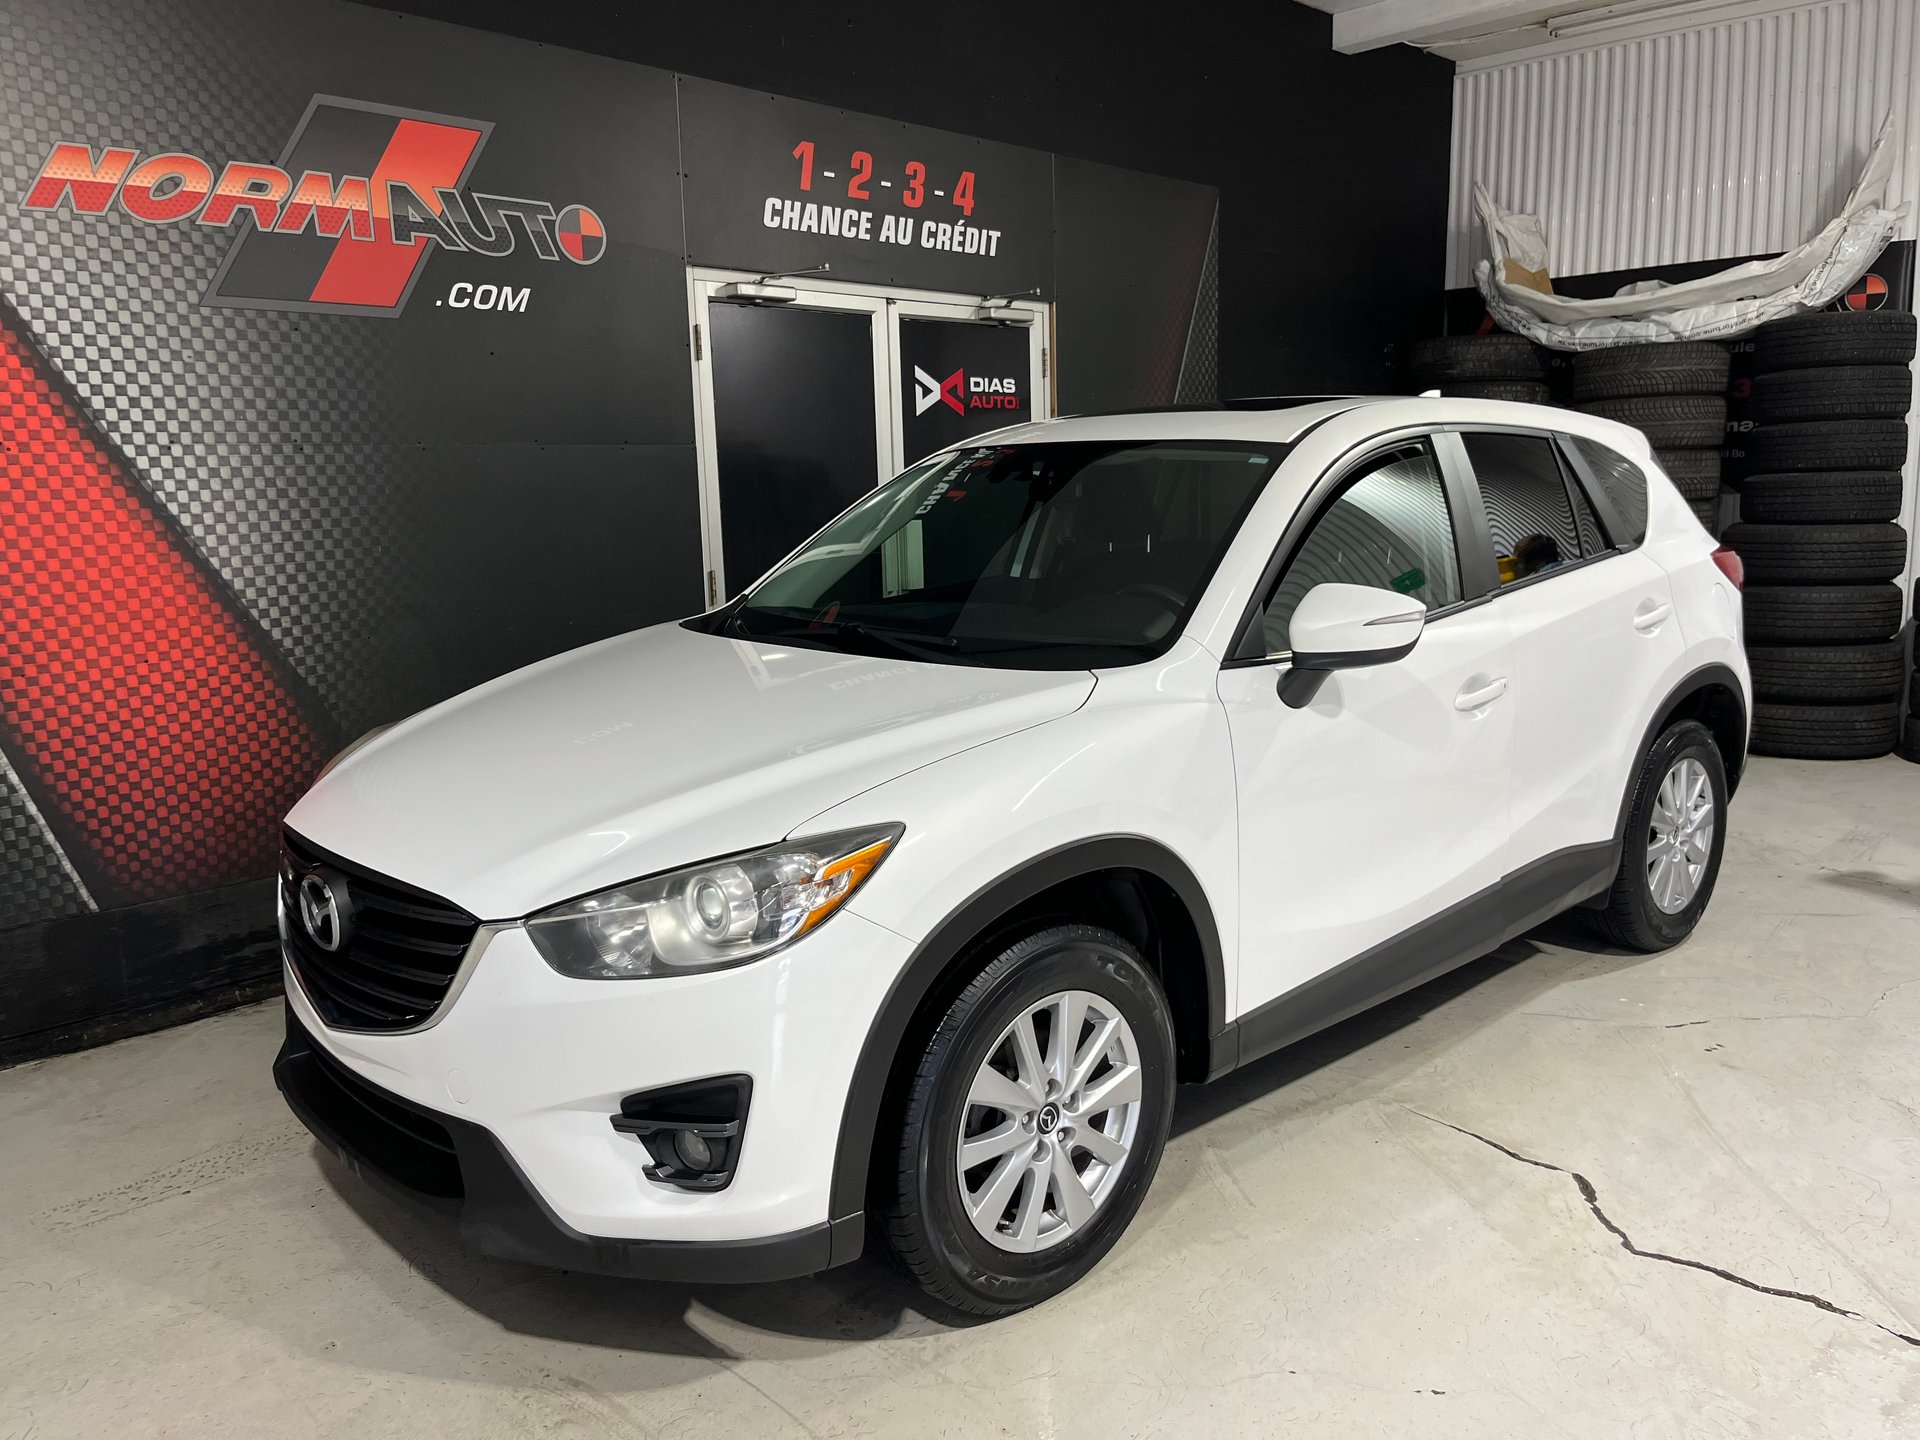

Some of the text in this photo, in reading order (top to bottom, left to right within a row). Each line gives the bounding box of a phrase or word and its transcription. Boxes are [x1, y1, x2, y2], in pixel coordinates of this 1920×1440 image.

[763, 197, 1001, 257] CHANCE AU CRÉDIT
[969, 377, 1016, 393] DIAS
